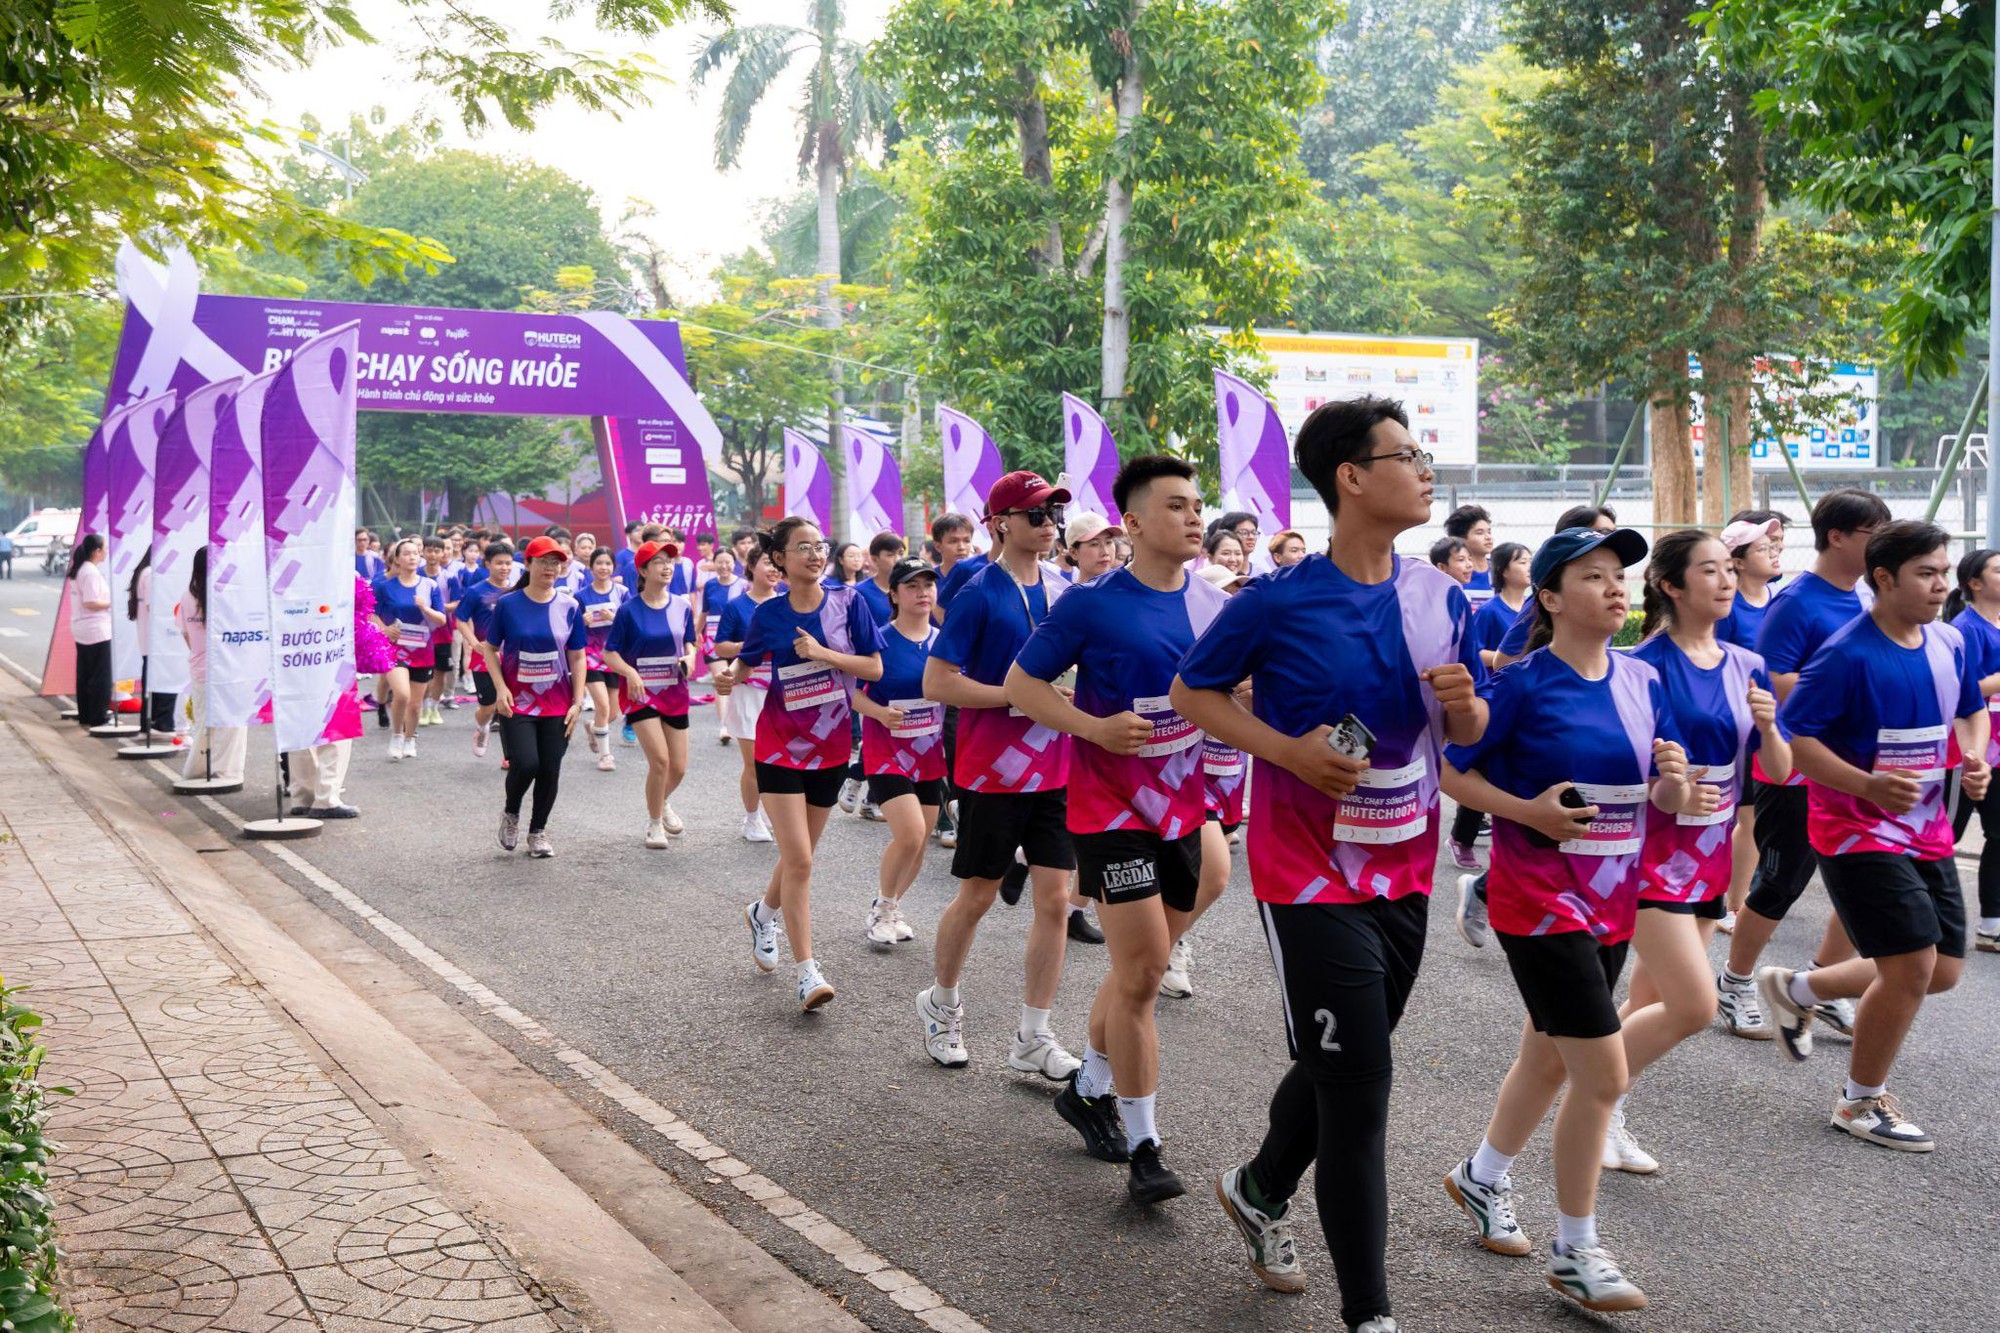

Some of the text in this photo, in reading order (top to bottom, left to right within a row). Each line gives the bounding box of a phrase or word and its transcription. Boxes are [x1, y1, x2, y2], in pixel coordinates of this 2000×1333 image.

[537, 332, 581, 344] HUTECH
[356, 350, 580, 388] CHẠY SỐNG KHỎE
[357, 388, 380, 399] Hành
[382, 389, 403, 400] trình
[404, 390, 421, 401] chủ
[422, 390, 445, 404] động
[446, 393, 454, 402] vì
[455, 393, 472, 403] sức
[651, 512, 704, 528] START
[222, 630, 263, 646] napas
[281, 628, 322, 647] BƯỚC
[282, 649, 322, 668] SỐNG
[1156, 718, 1172, 726] CHẠY
[1364, 797, 1385, 807] CHẠY
[1385, 795, 1405, 806] SỐNG
[1340, 801, 1417, 820] HUTECH0074
[1102, 861, 1157, 889] LEGDAY
[1106, 863, 1122, 871] NO
[1314, 1008, 1342, 1052] 2
